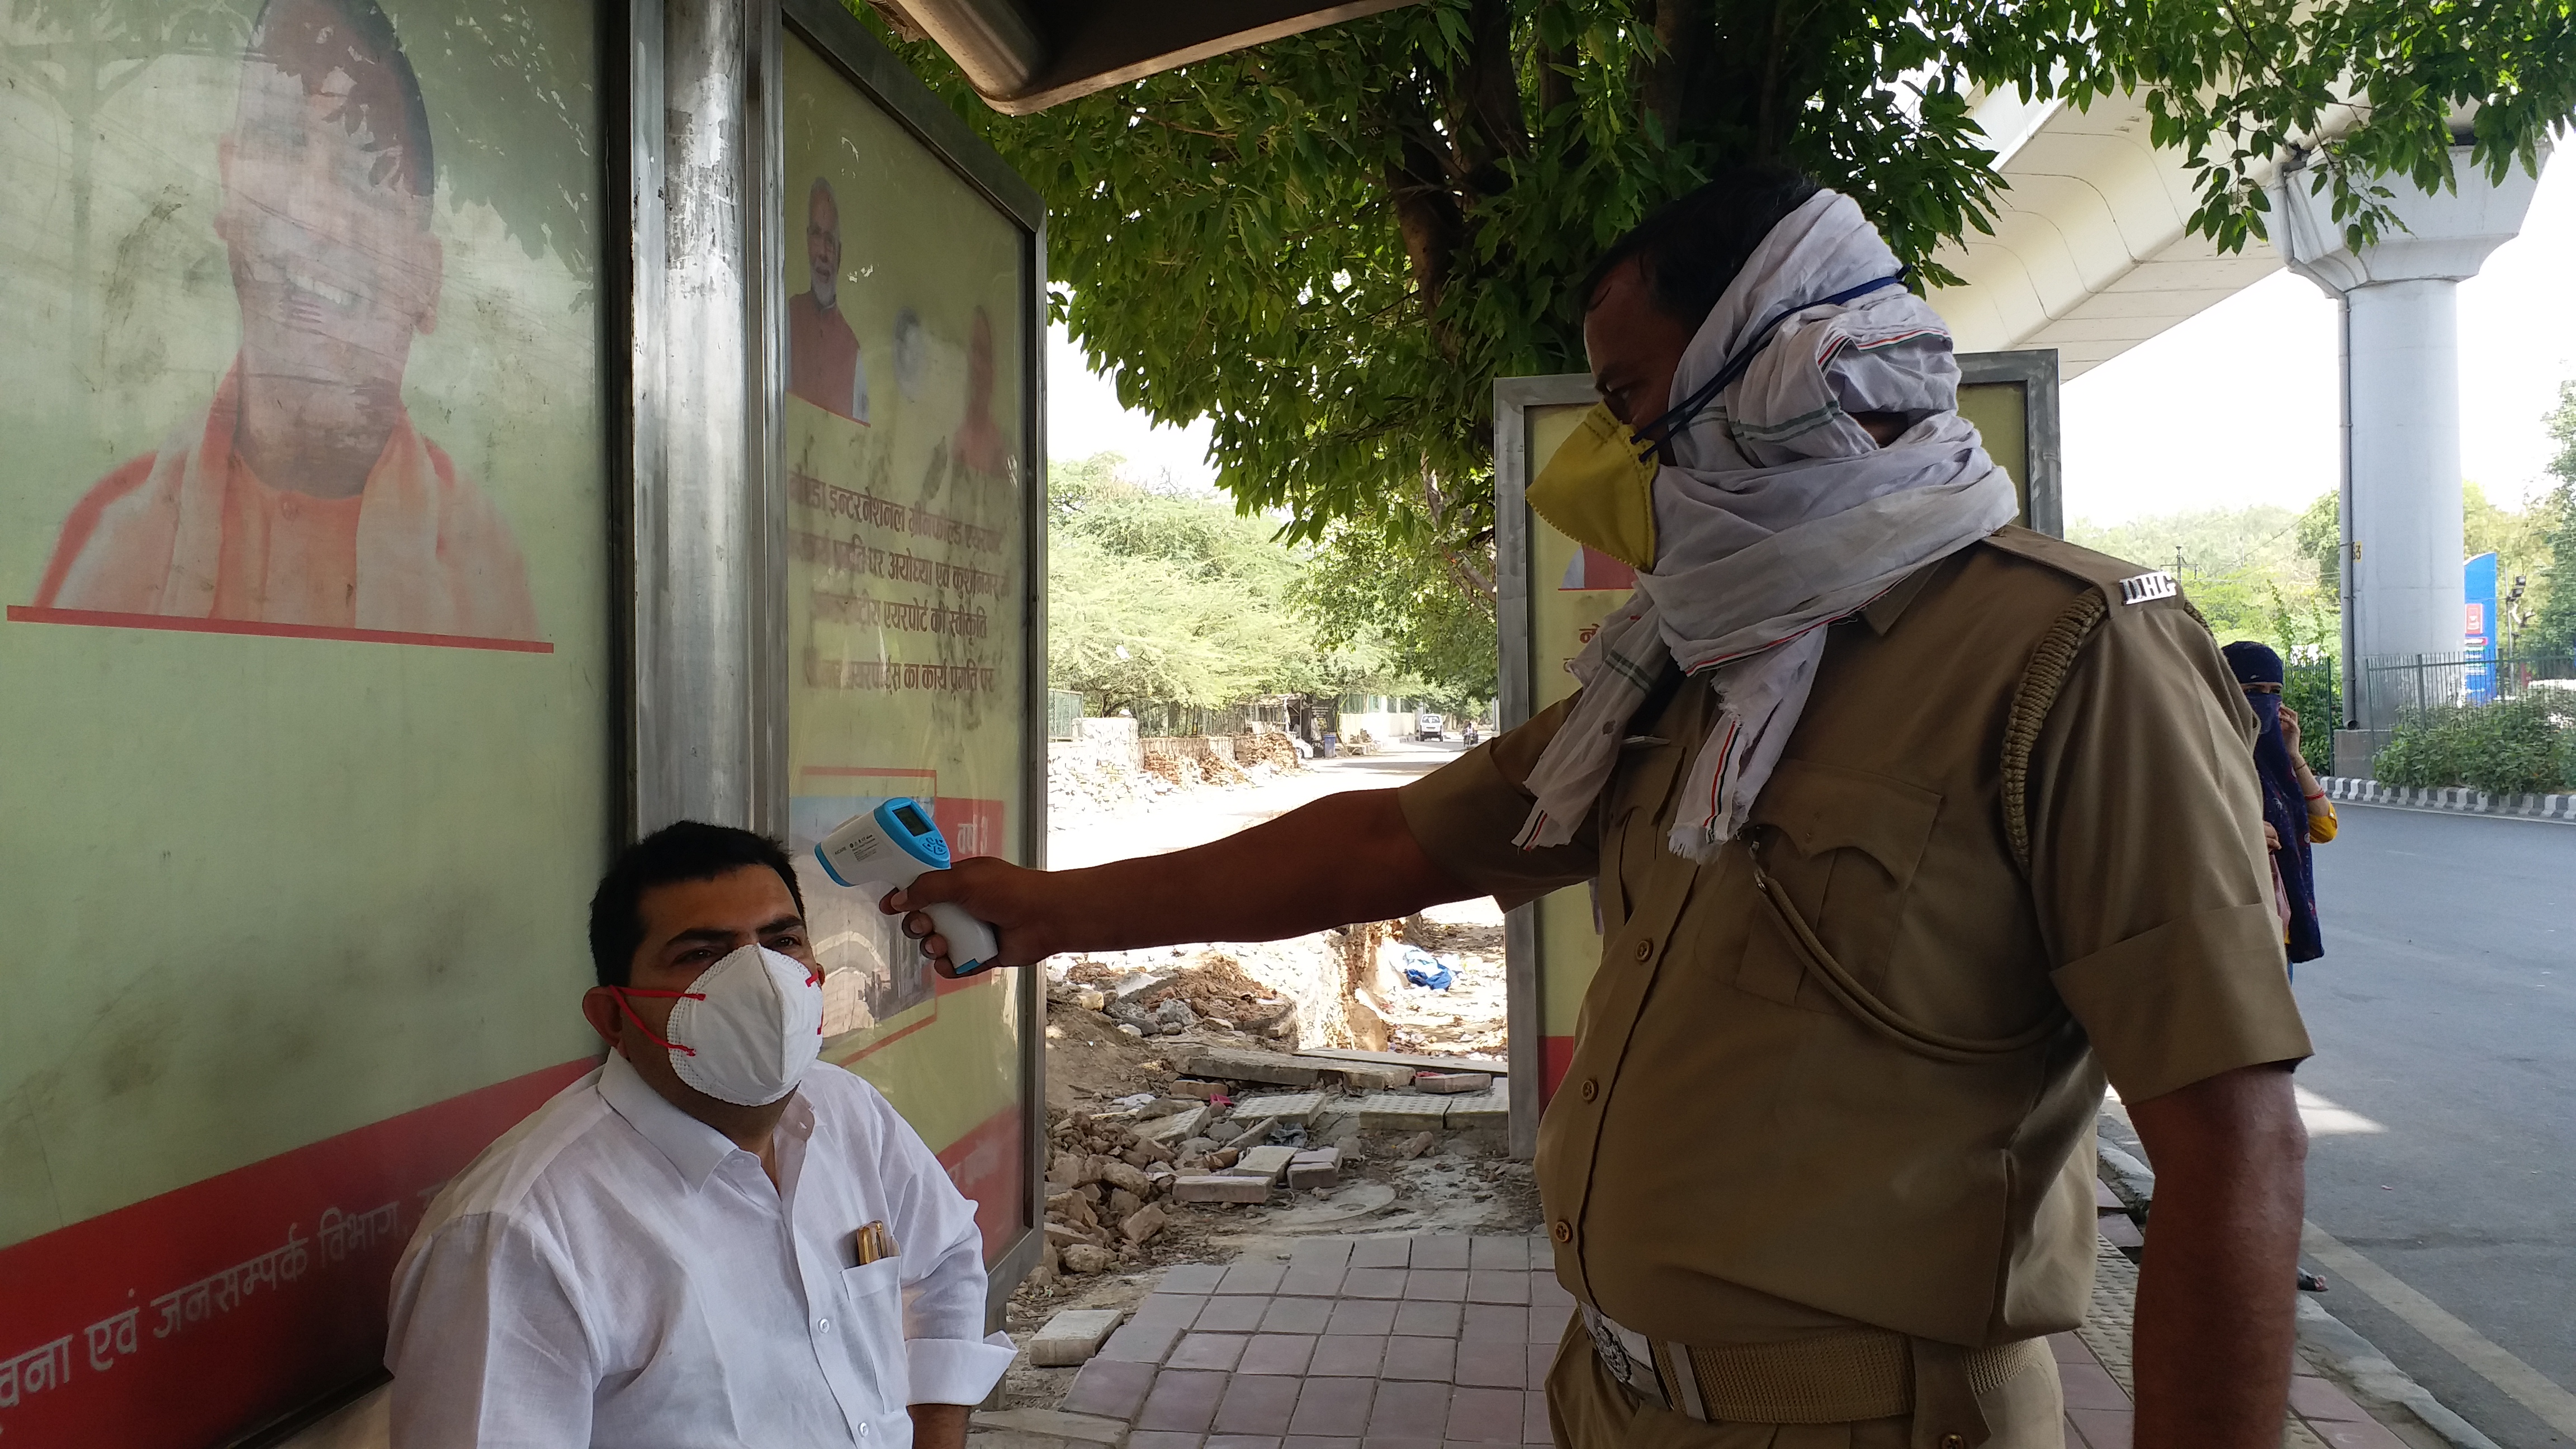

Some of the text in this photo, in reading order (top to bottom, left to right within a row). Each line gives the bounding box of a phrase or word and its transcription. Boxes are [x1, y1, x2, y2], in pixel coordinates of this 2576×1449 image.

[829, 485, 906, 532] इन्टरनेशनल
[888, 548, 933, 585] अयोध्या
[883, 597, 929, 632] एयरपोर्ट
[948, 604, 987, 646] स्वीकृति
[903, 663, 920, 690] का
[922, 657, 948, 690] कार्य
[950, 658, 978, 695] प्रगति
[979, 667, 995, 693] पर
[84, 1288, 140, 1371] एवं
[151, 1223, 307, 1339] जनसम्पर्क
